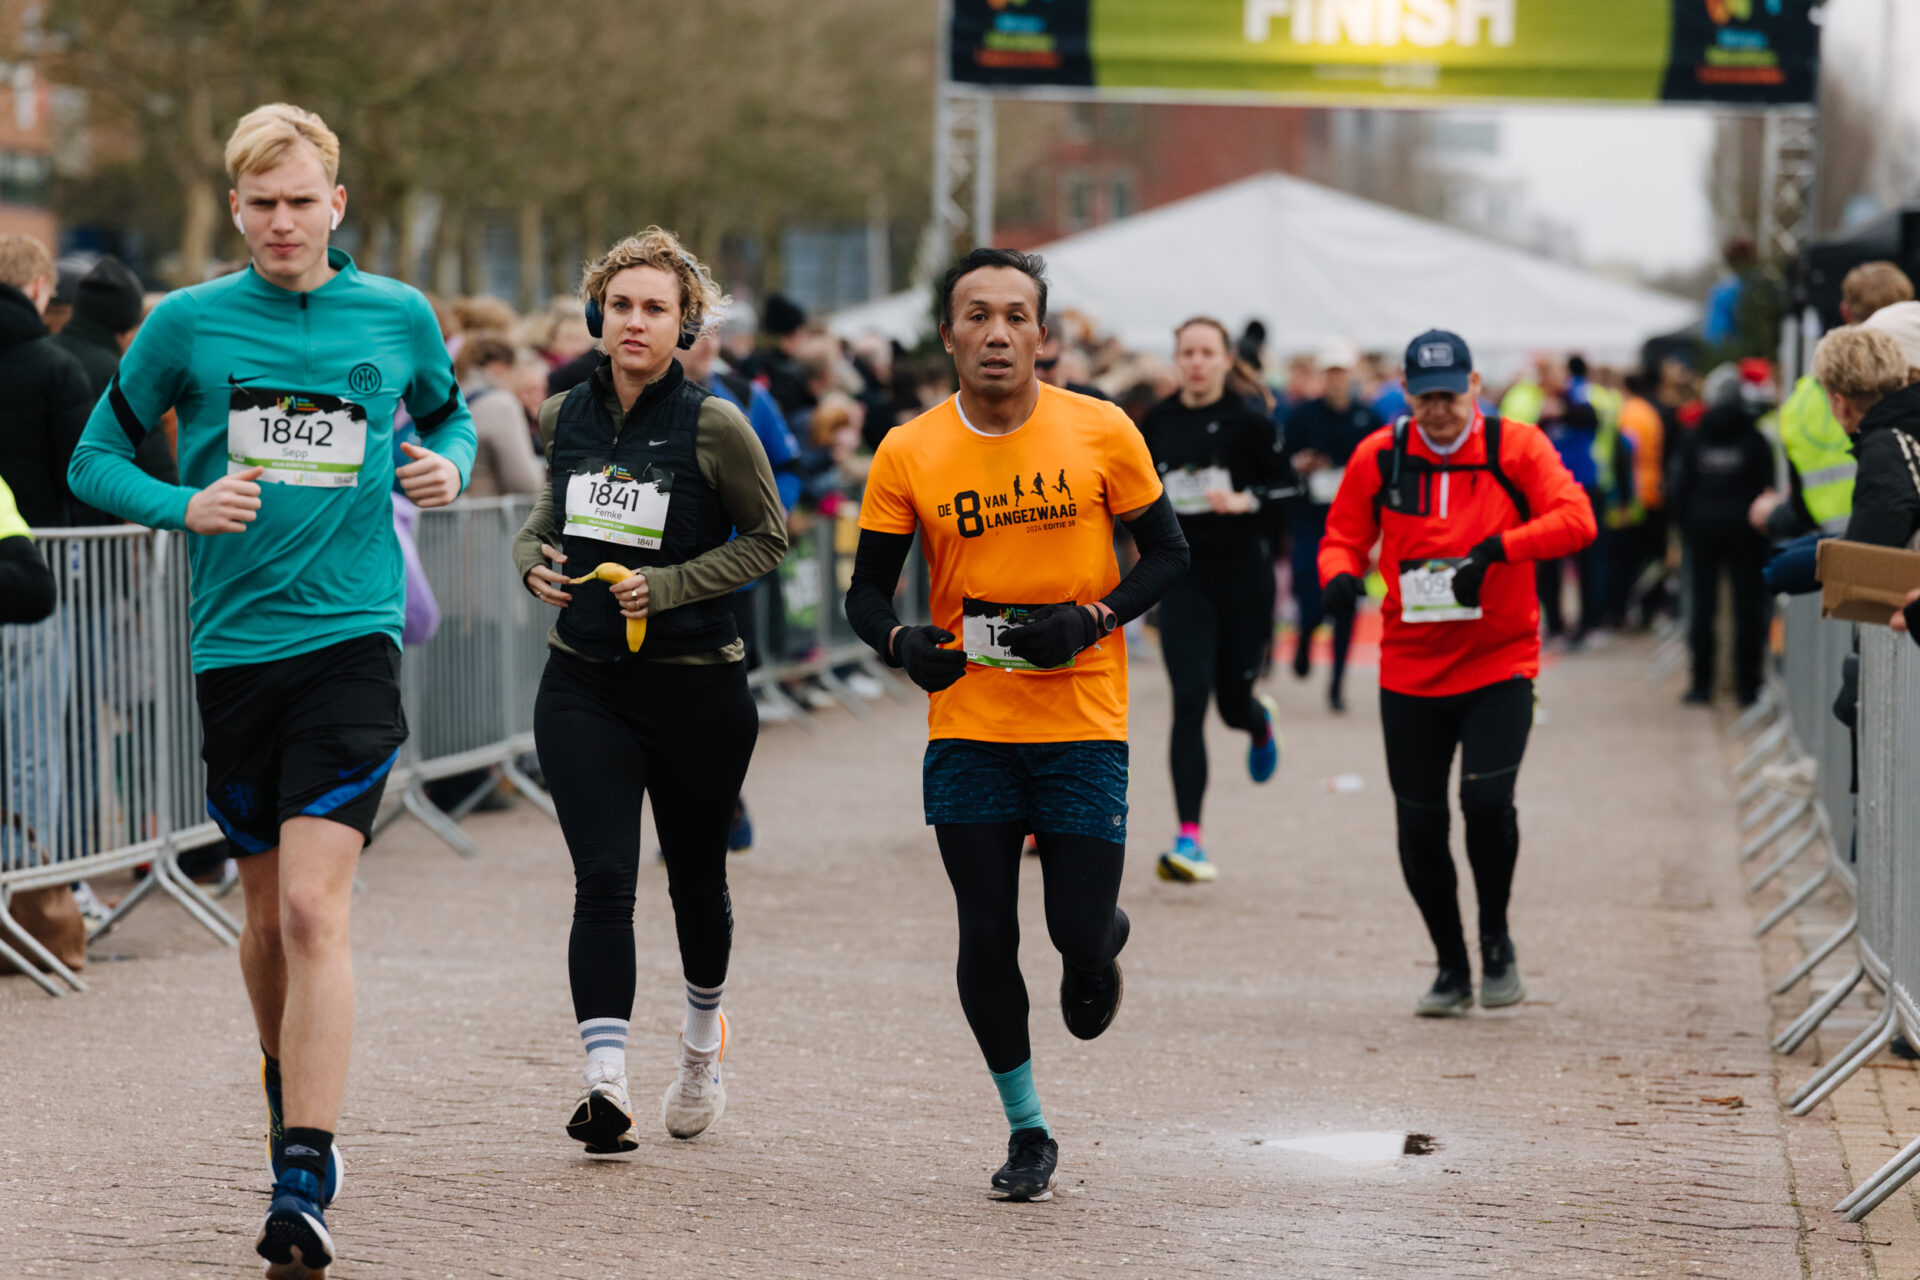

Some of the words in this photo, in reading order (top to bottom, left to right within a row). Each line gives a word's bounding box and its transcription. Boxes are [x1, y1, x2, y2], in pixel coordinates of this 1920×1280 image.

[1243, 0, 1516, 47] FINISH
[260, 417, 333, 446] 1842
[281, 448, 308, 460] Sepp
[589, 482, 640, 512] 1841
[595, 508, 623, 520] Femke
[938, 503, 952, 518] DE
[954, 490, 984, 538] 8
[983, 493, 1008, 509] VAN
[985, 503, 1077, 529] LANGEZWAAG
[1026, 525, 1042, 533] 2024
[1043, 521, 1067, 530] EDITIE
[637, 538, 654, 547] 1841
